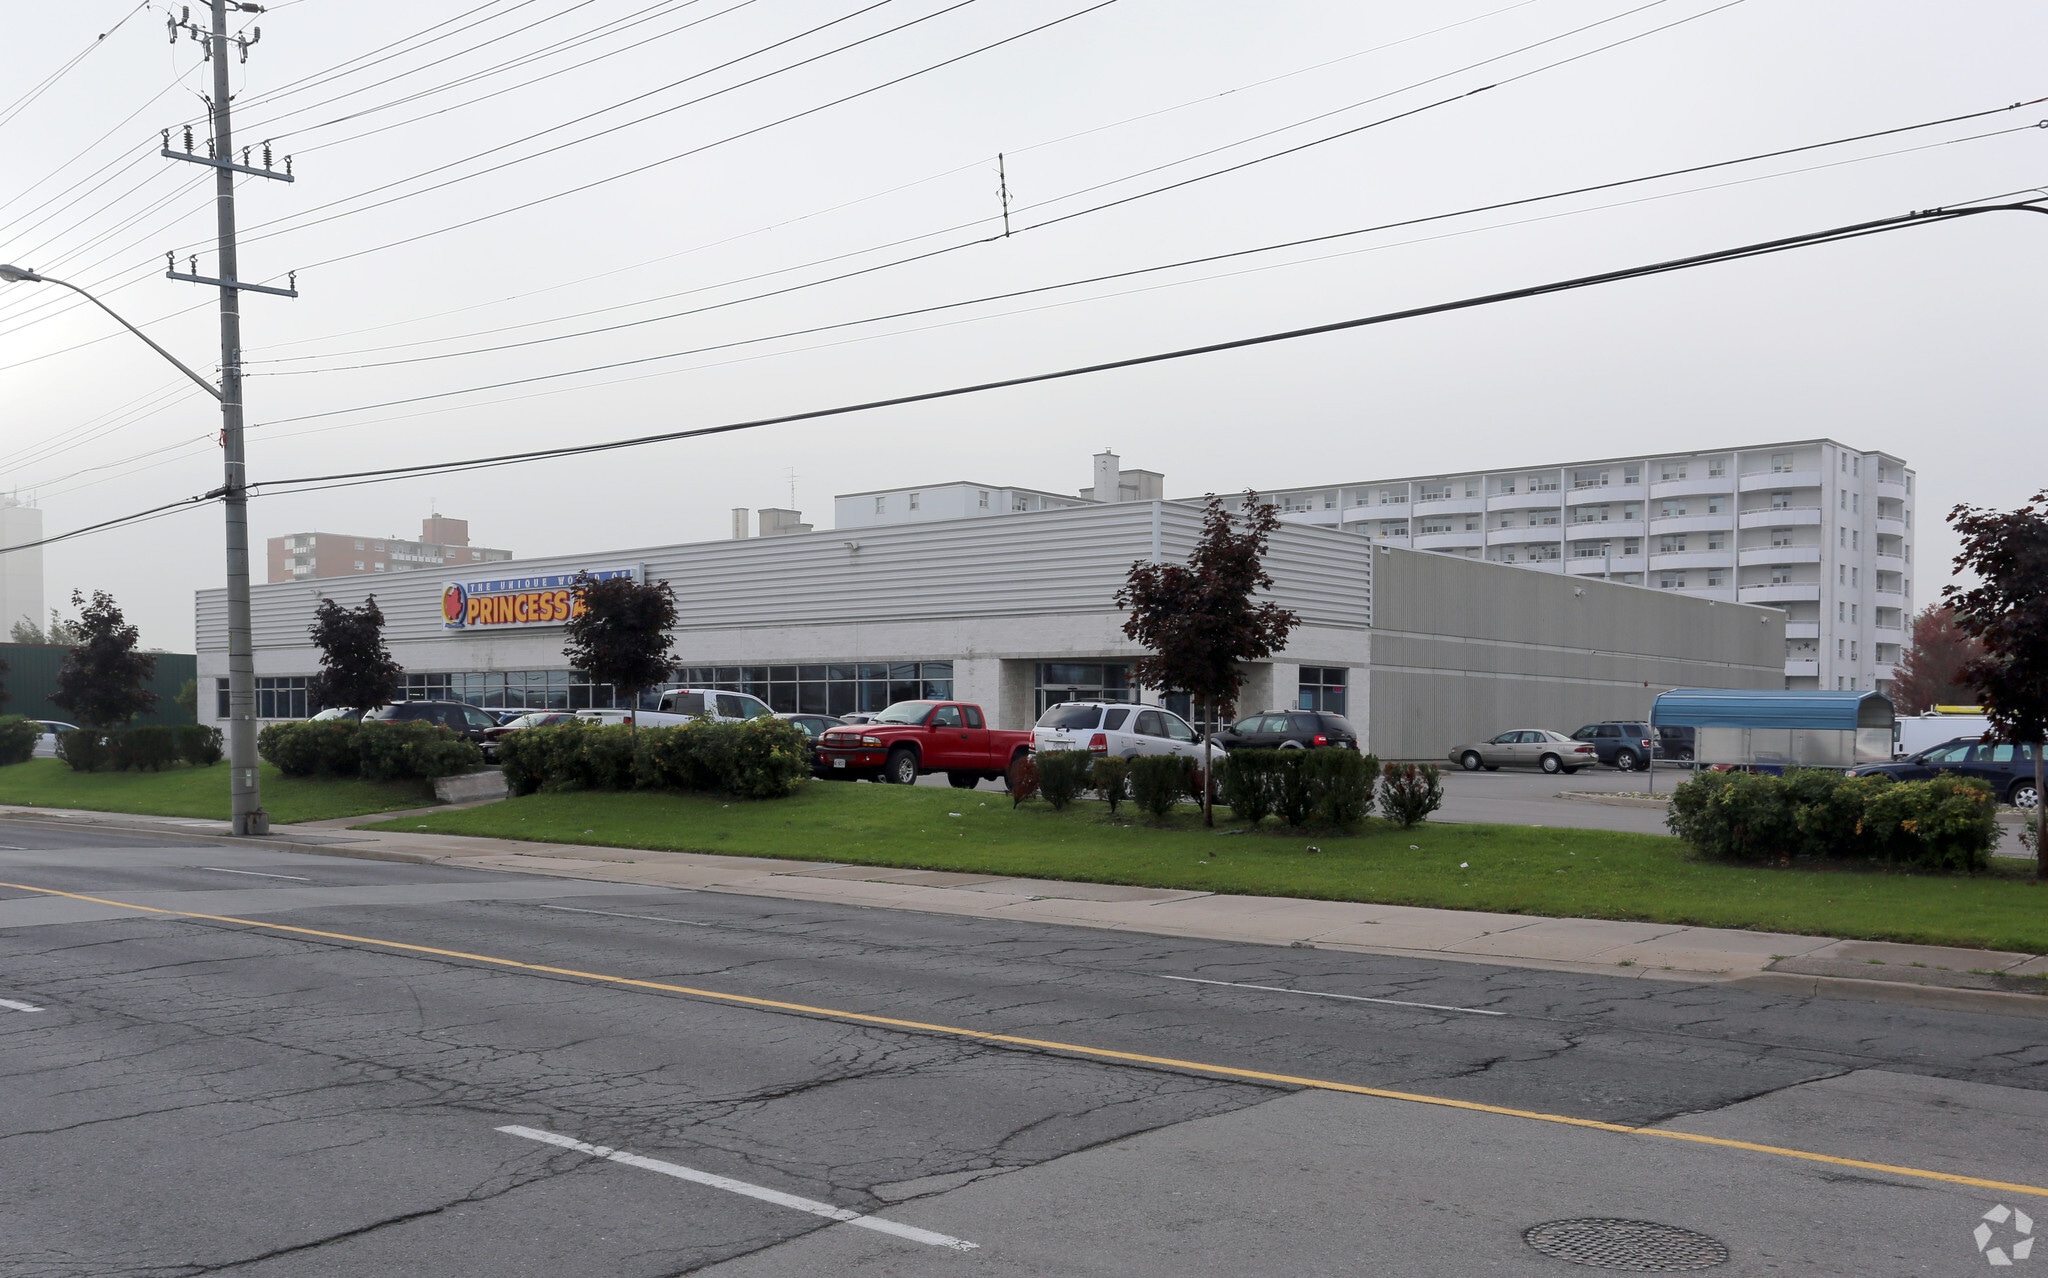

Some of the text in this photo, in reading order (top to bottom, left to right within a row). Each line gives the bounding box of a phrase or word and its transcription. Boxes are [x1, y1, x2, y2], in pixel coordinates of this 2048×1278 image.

[470, 582, 491, 592] THE
[500, 577, 547, 590] UNIQUE
[467, 590, 570, 624] PRINCESS
